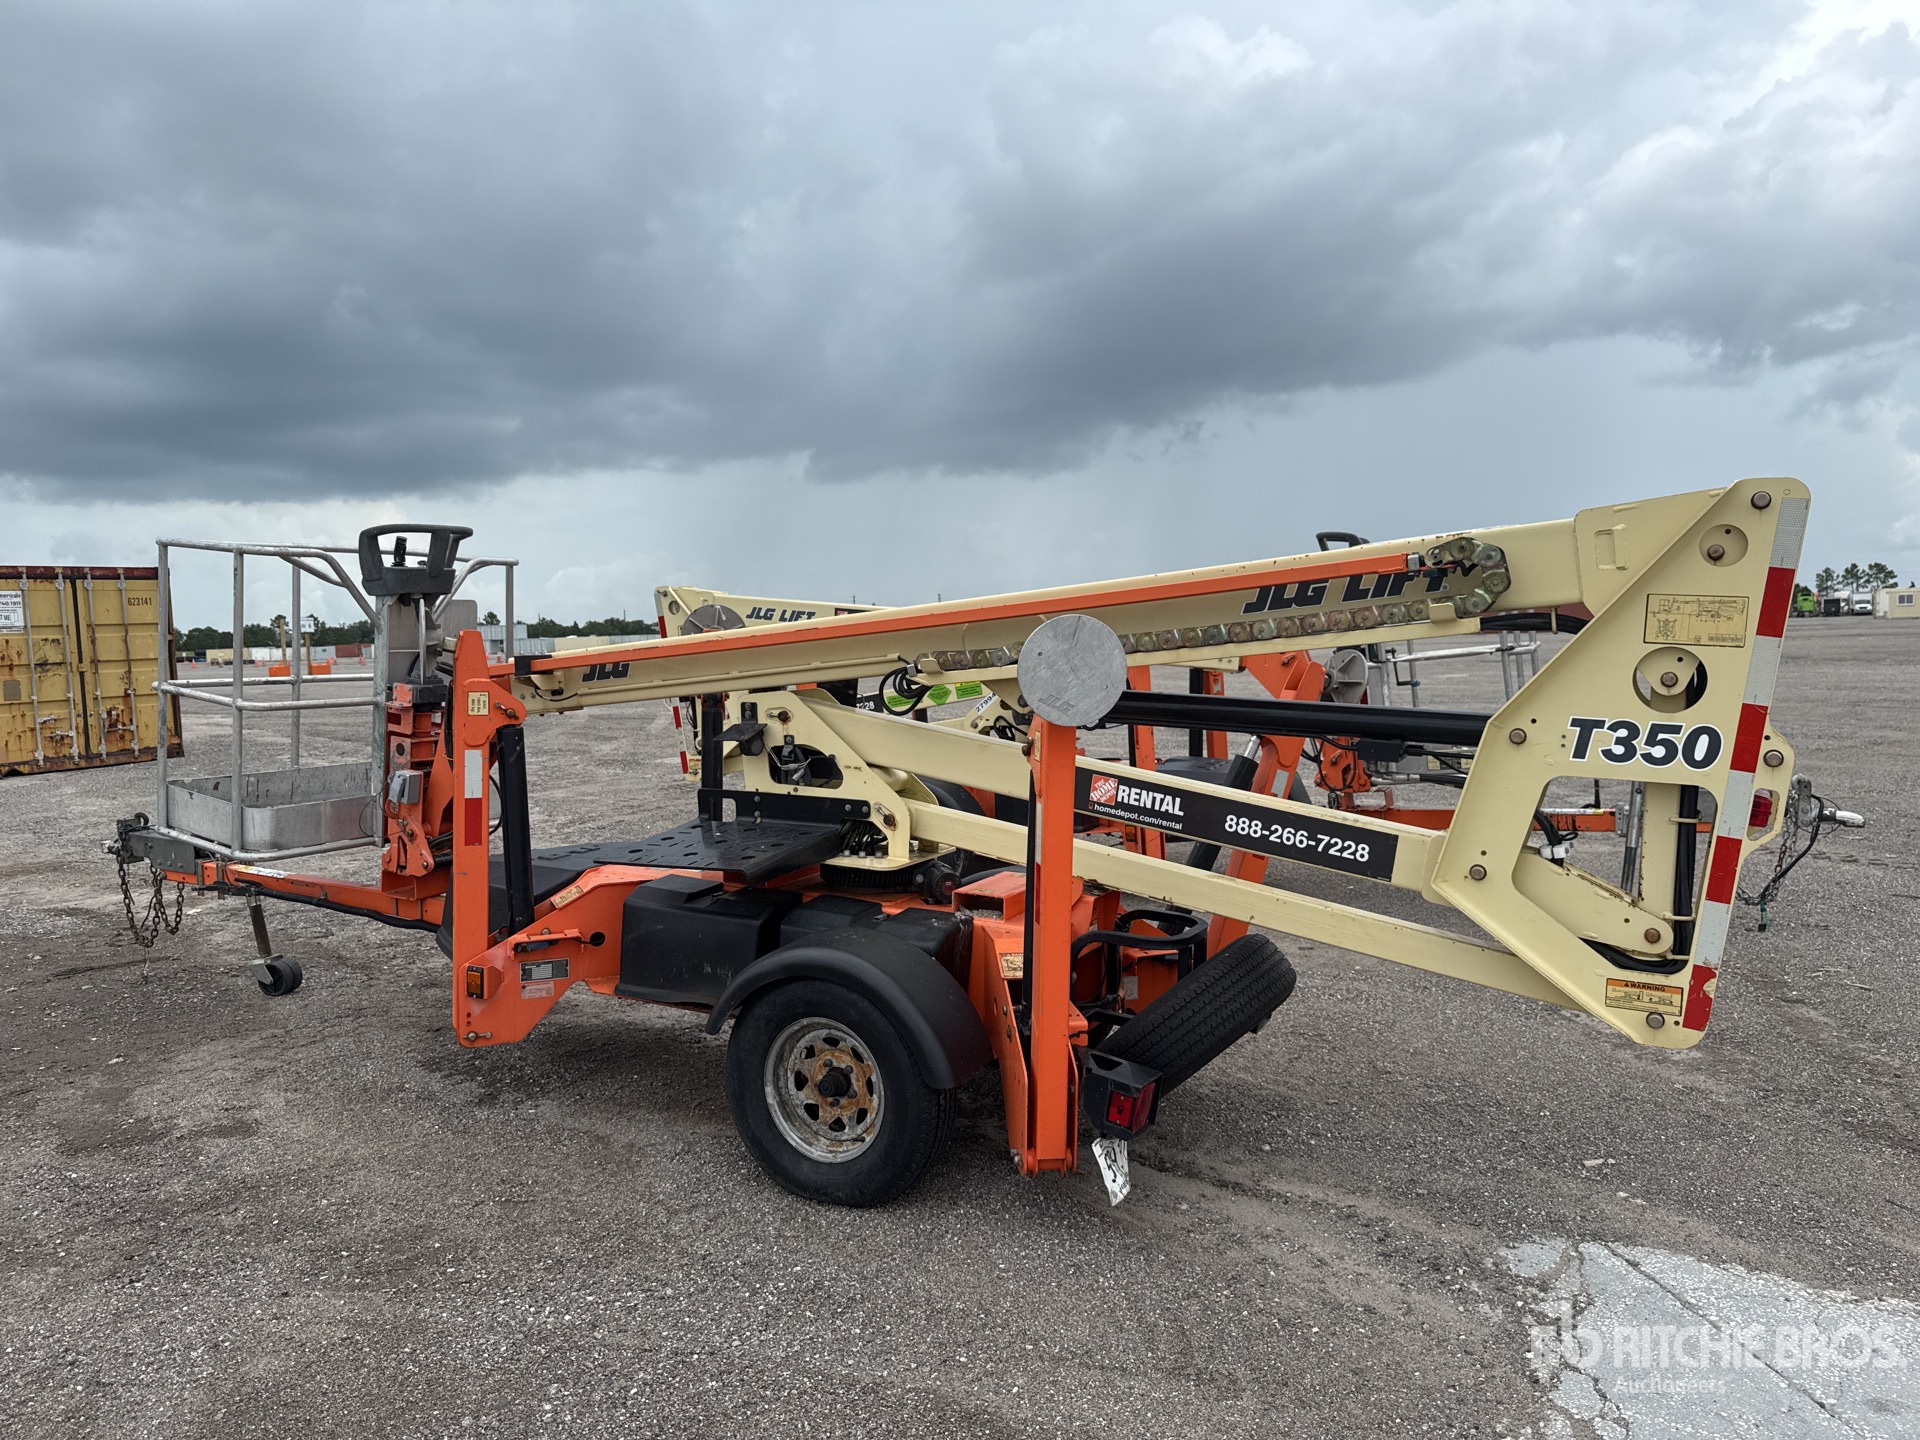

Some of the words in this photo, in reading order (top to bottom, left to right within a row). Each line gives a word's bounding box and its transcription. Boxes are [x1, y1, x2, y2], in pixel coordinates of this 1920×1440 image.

[127, 597, 152, 606] 623141
[1240, 578, 1330, 615] JLG
[746, 607, 776, 621] JLG
[779, 609, 816, 622] LIFT
[581, 662, 631, 683] JLG
[1038, 694, 1075, 716] JLG
[1567, 716, 1724, 771] T350
[1090, 778, 1118, 801] HOME
[1094, 779, 1106, 789] THE
[1117, 785, 1184, 816] RENTAL
[1094, 804, 1183, 830] homedepot.com/rental
[1224, 815, 1370, 862] 888-266-7228
[1630, 983, 1666, 992] WARNING
